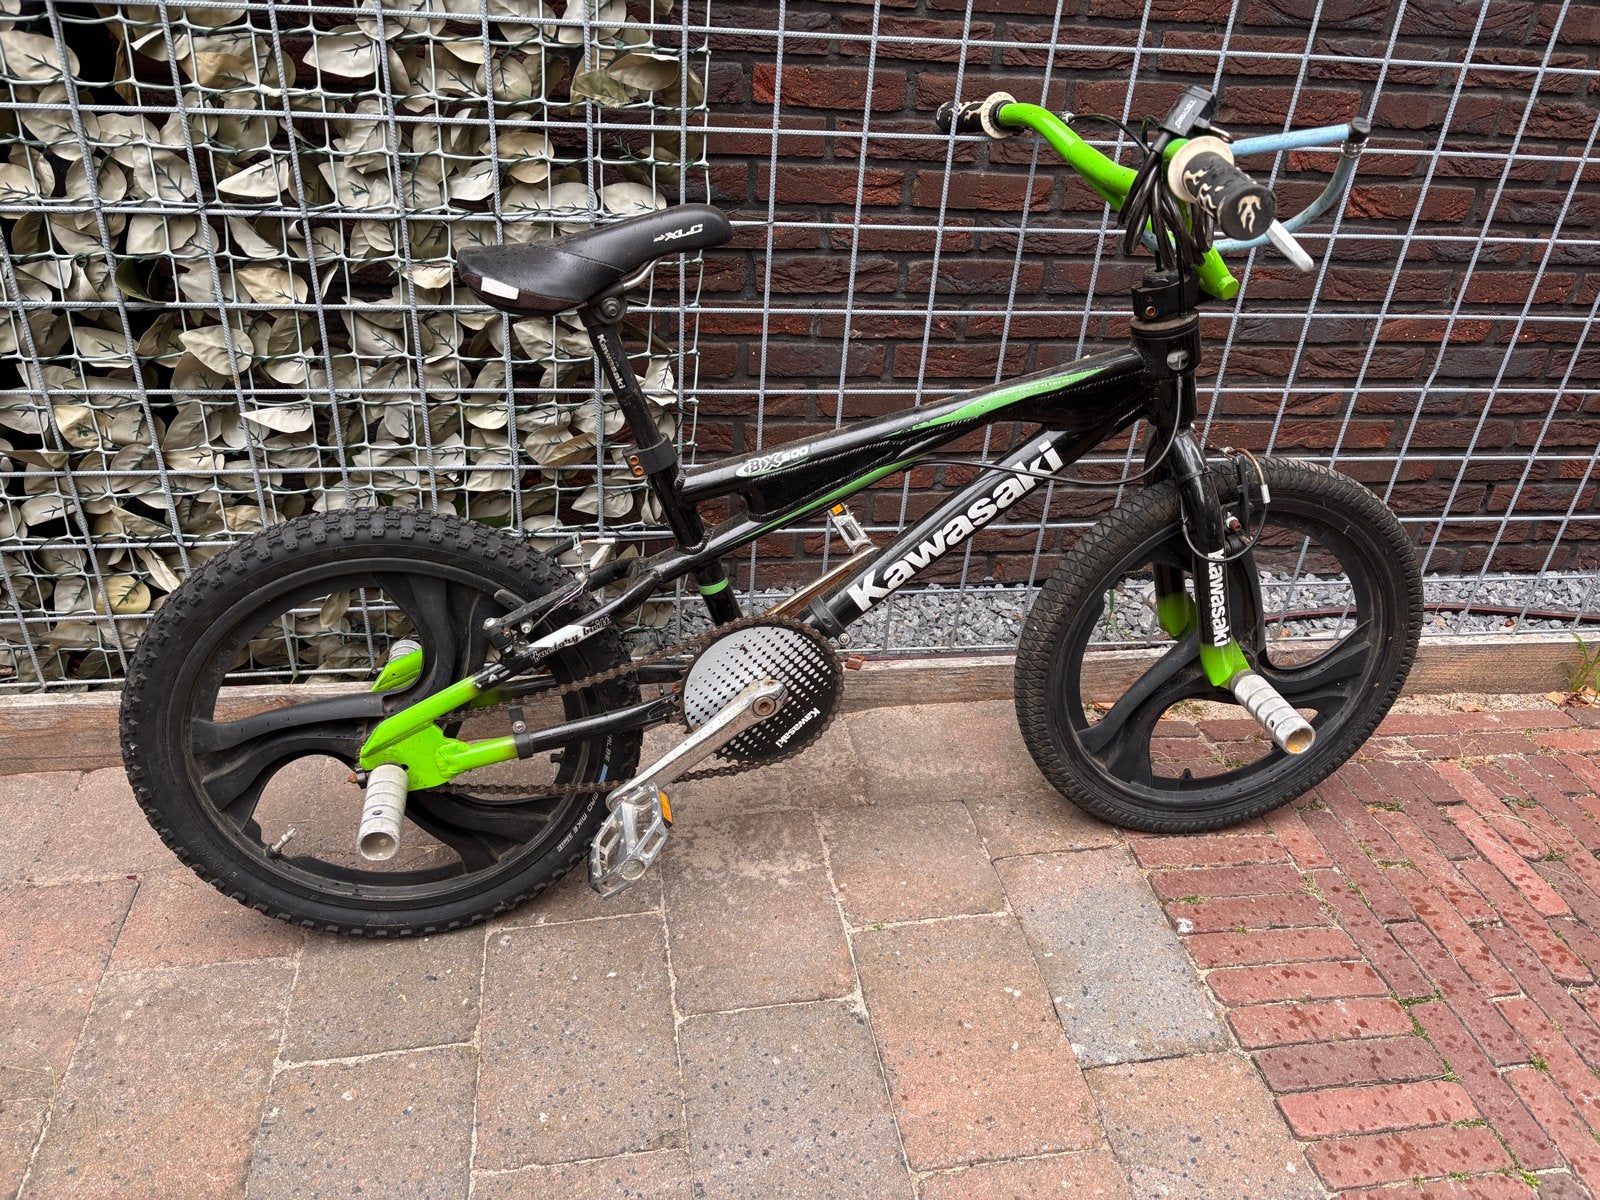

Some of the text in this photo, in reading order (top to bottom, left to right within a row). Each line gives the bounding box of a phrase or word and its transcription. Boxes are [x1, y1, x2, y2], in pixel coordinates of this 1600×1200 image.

[665, 224, 703, 241] XLC
[597, 334, 626, 390] Kawasaki
[847, 440, 1064, 612] Kawasaki
[1208, 548, 1231, 647] Kawasaki
[775, 707, 821, 748] Kawasaki
[573, 792, 599, 834] MAD MIKE
